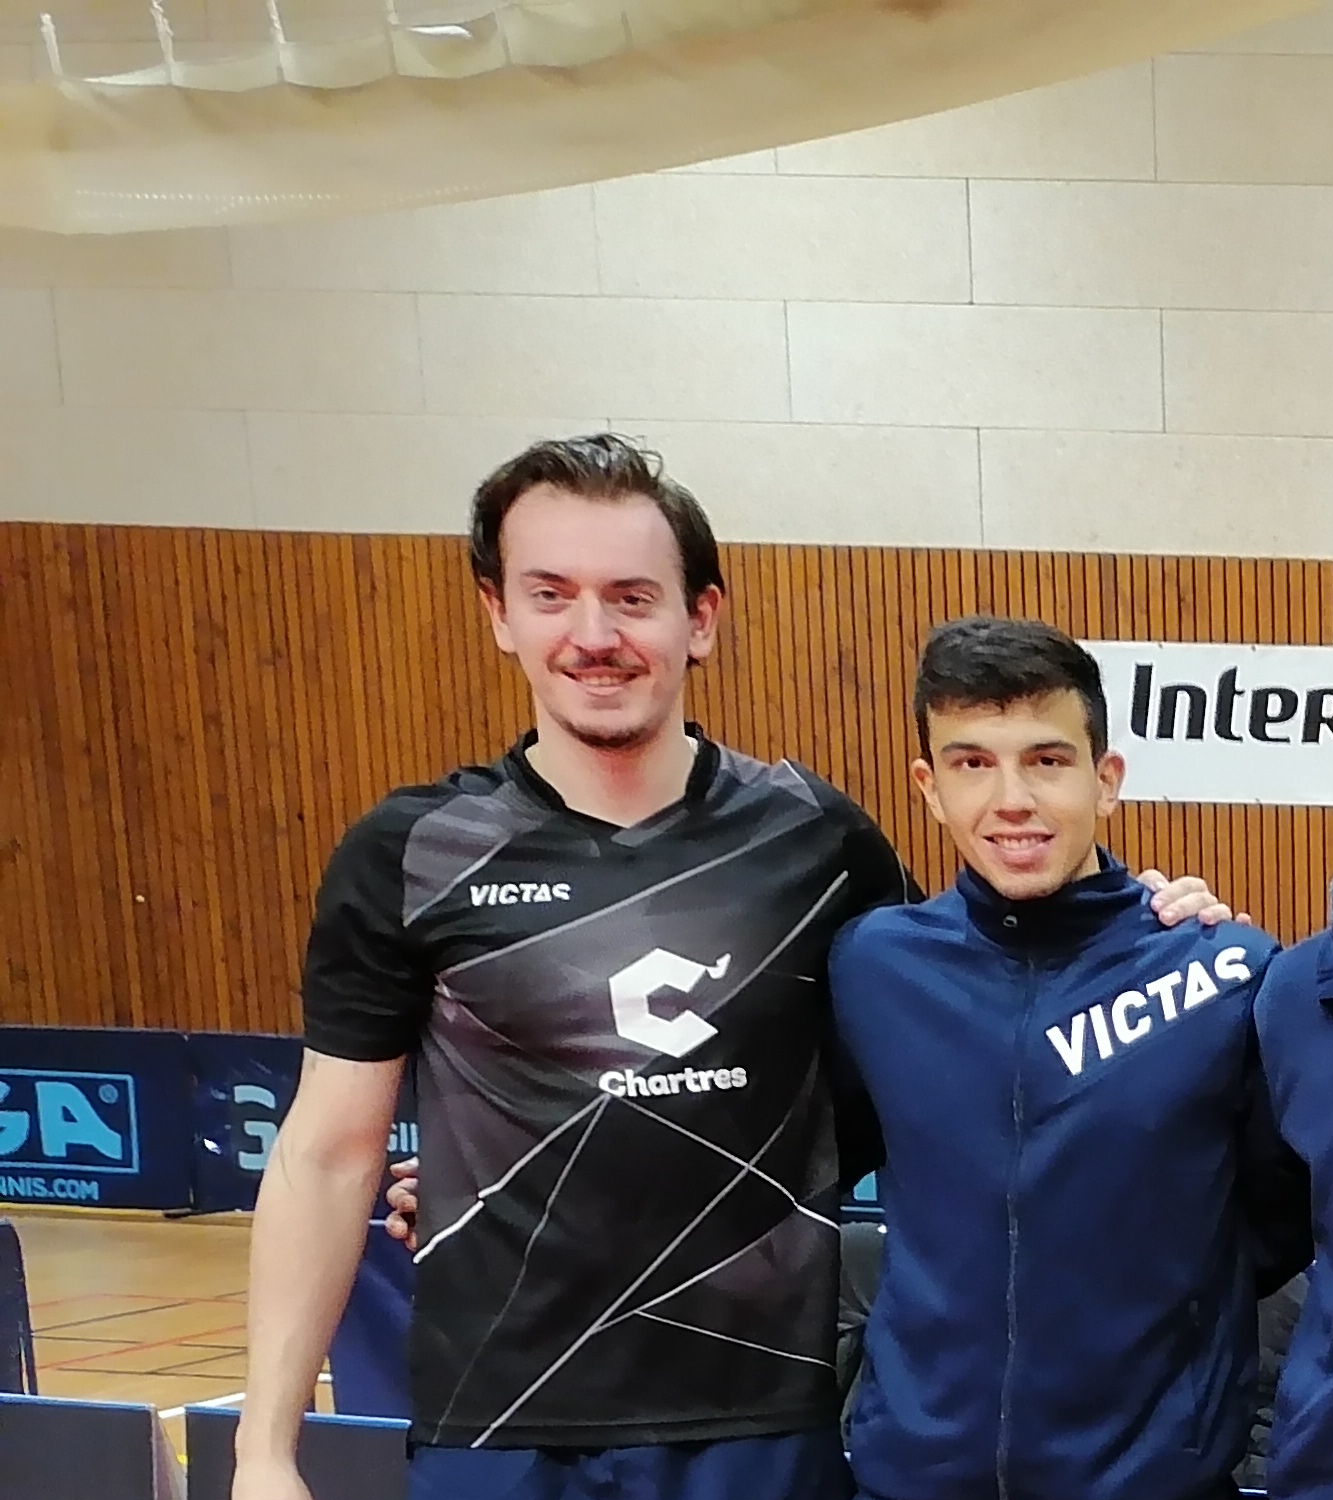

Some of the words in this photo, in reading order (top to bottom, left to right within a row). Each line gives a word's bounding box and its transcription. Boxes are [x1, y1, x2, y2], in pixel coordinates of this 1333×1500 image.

[469, 882, 571, 907] VICTAS
[1045, 946, 1251, 1077] VICTAS
[599, 1066, 747, 1098] Chartres
